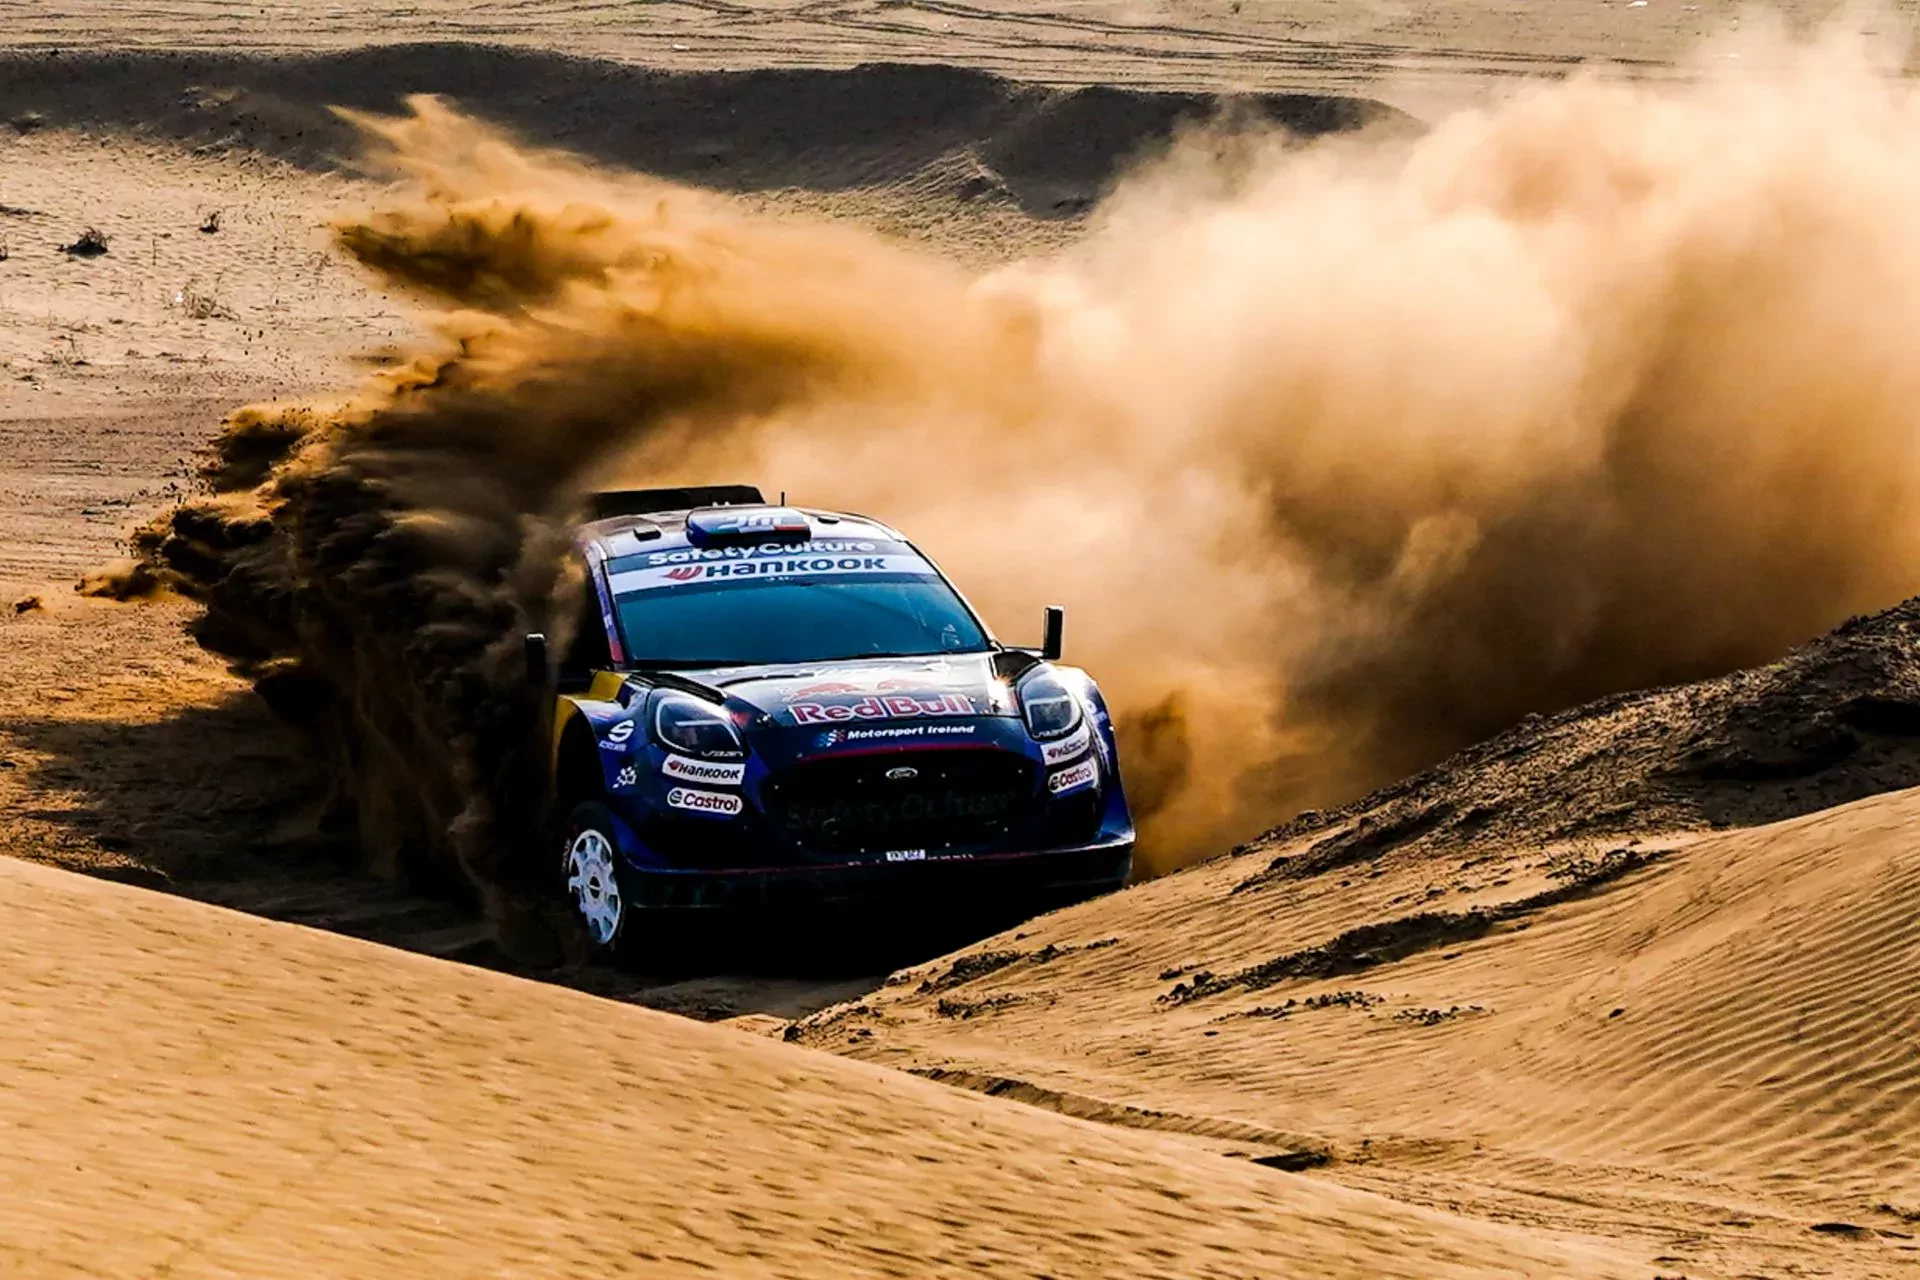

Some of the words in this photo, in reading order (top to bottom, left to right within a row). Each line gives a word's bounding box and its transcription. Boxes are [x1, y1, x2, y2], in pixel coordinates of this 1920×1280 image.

[789, 697, 888, 725] Red
[887, 693, 977, 718] Bull
[847, 726, 925, 741] Motorsport
[927, 724, 976, 735] Ireland
[683, 792, 739, 813] Castrol
